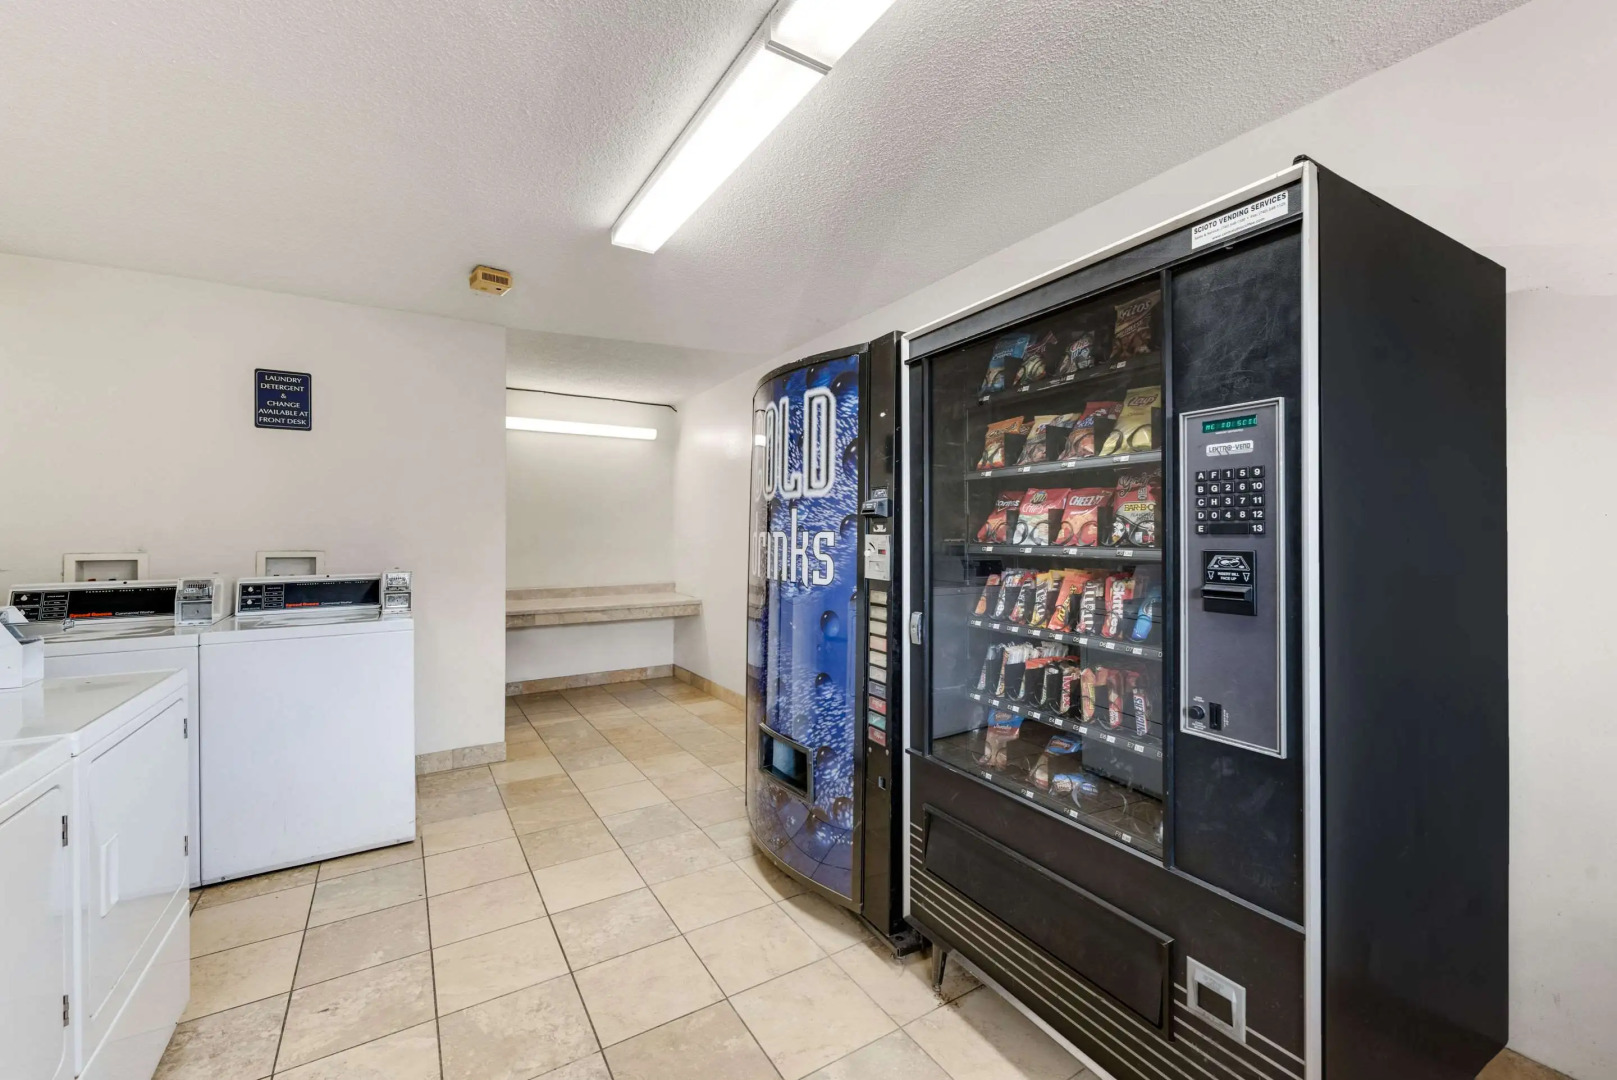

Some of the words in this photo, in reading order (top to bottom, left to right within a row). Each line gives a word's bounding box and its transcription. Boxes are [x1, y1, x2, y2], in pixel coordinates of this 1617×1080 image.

[1193, 220, 1217, 235] SCIOTO
[1218, 207, 1249, 224] VENDING
[1250, 192, 1287, 212] SERVICES
[265, 375, 302, 383] LAUNDRY
[260, 382, 305, 392] DETERGENT
[266, 400, 301, 408] CHANGE
[258, 408, 298, 416] AVAILABLE
[259, 416, 286, 424] FRONT
[1254, 468, 1260, 476] 9
[1109, 581, 1125, 635] Skittles
[1134, 694, 1148, 736] SNICKERS
